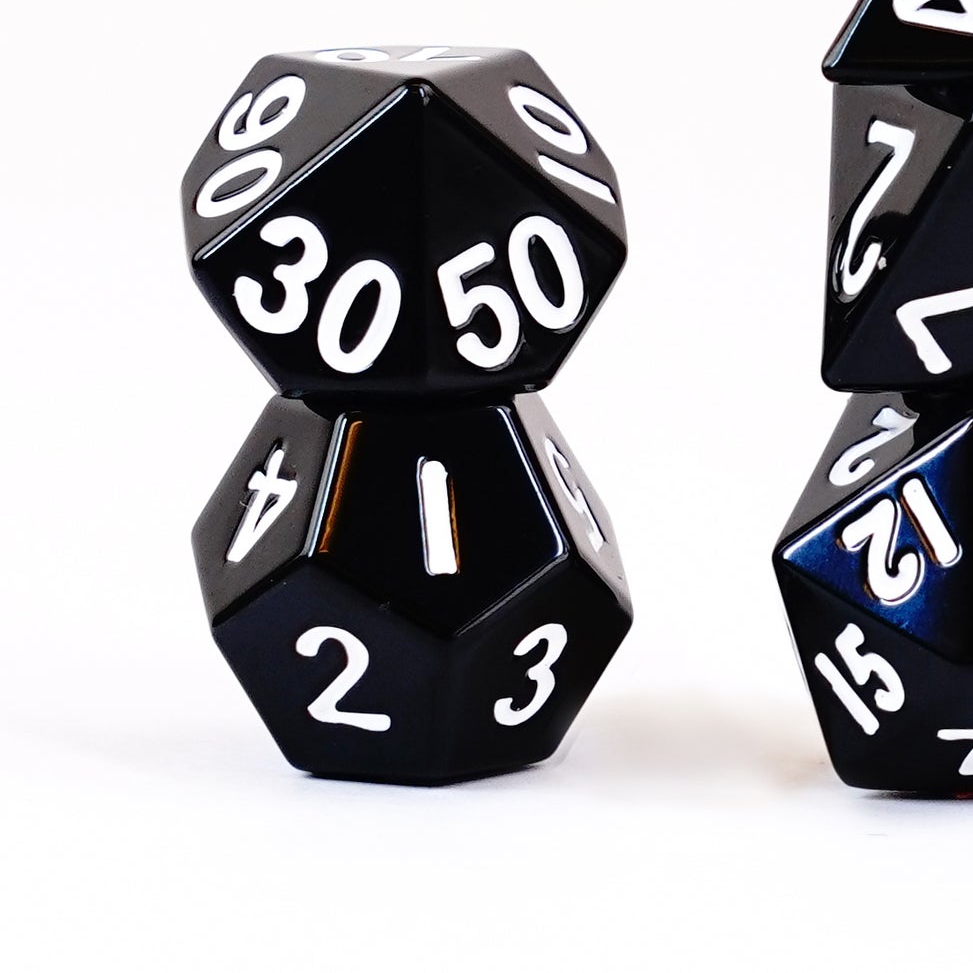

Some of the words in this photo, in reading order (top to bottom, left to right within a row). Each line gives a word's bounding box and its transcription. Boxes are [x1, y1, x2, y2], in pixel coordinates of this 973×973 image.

[196, 76, 306, 218] 90
[507, 86, 615, 204] 10
[233, 216, 401, 373] 30
[438, 216, 583, 367] 50
[227, 449, 297, 562] 4
[829, 408, 917, 486] 2
[418, 458, 457, 575] 1
[842, 479, 962, 606] 12
[296, 627, 390, 731] 2
[494, 624, 567, 725] 3
[815, 623, 904, 735] 15
